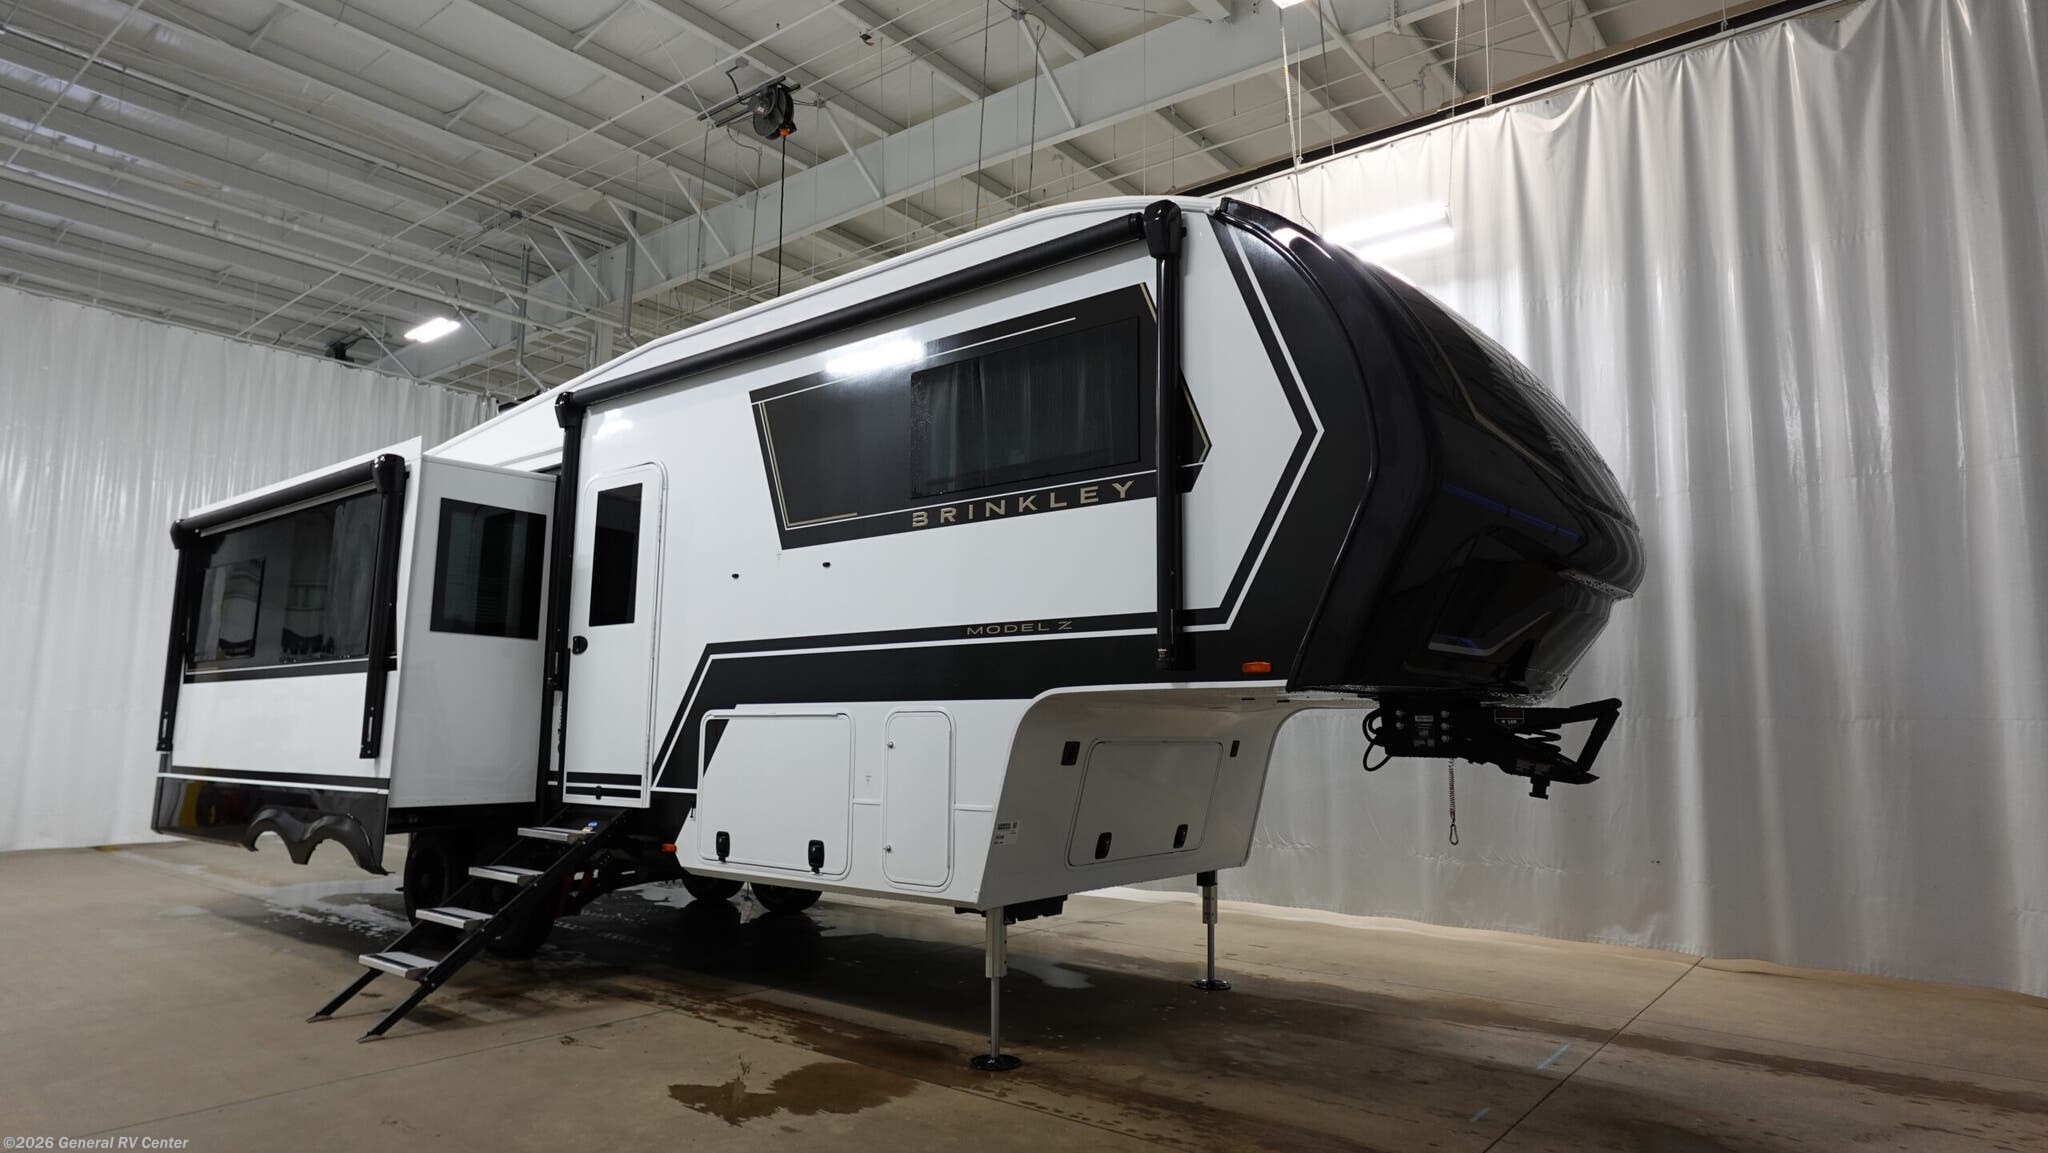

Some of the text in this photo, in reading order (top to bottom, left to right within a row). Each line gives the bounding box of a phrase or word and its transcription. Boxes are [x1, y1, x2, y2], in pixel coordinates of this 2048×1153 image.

[911, 480, 1135, 528] BRINKLEY
[966, 620, 1073, 636] MODEL Z
